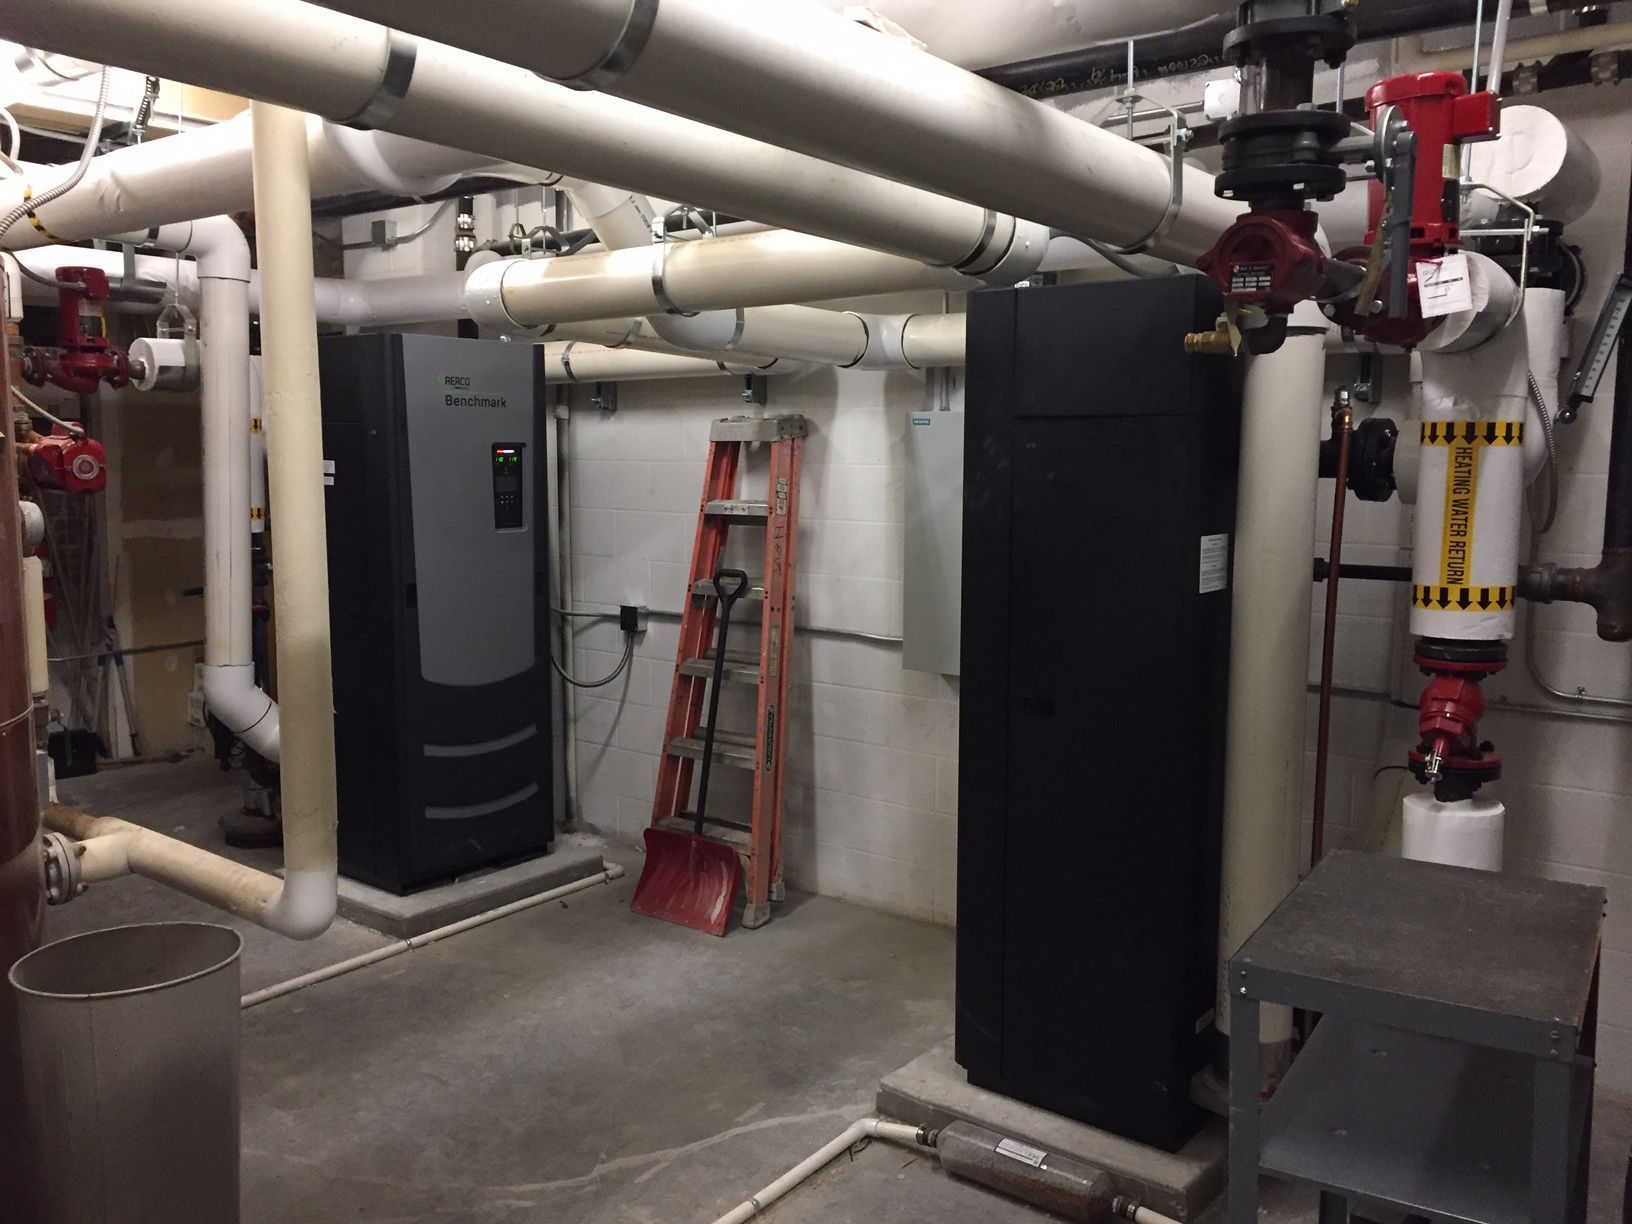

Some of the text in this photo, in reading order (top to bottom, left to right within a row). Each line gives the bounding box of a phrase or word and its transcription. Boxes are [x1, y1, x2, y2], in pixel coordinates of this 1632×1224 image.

[445, 394, 507, 408] Benchmark
[1446, 446, 1473, 585] HEATING WATER RETURN
